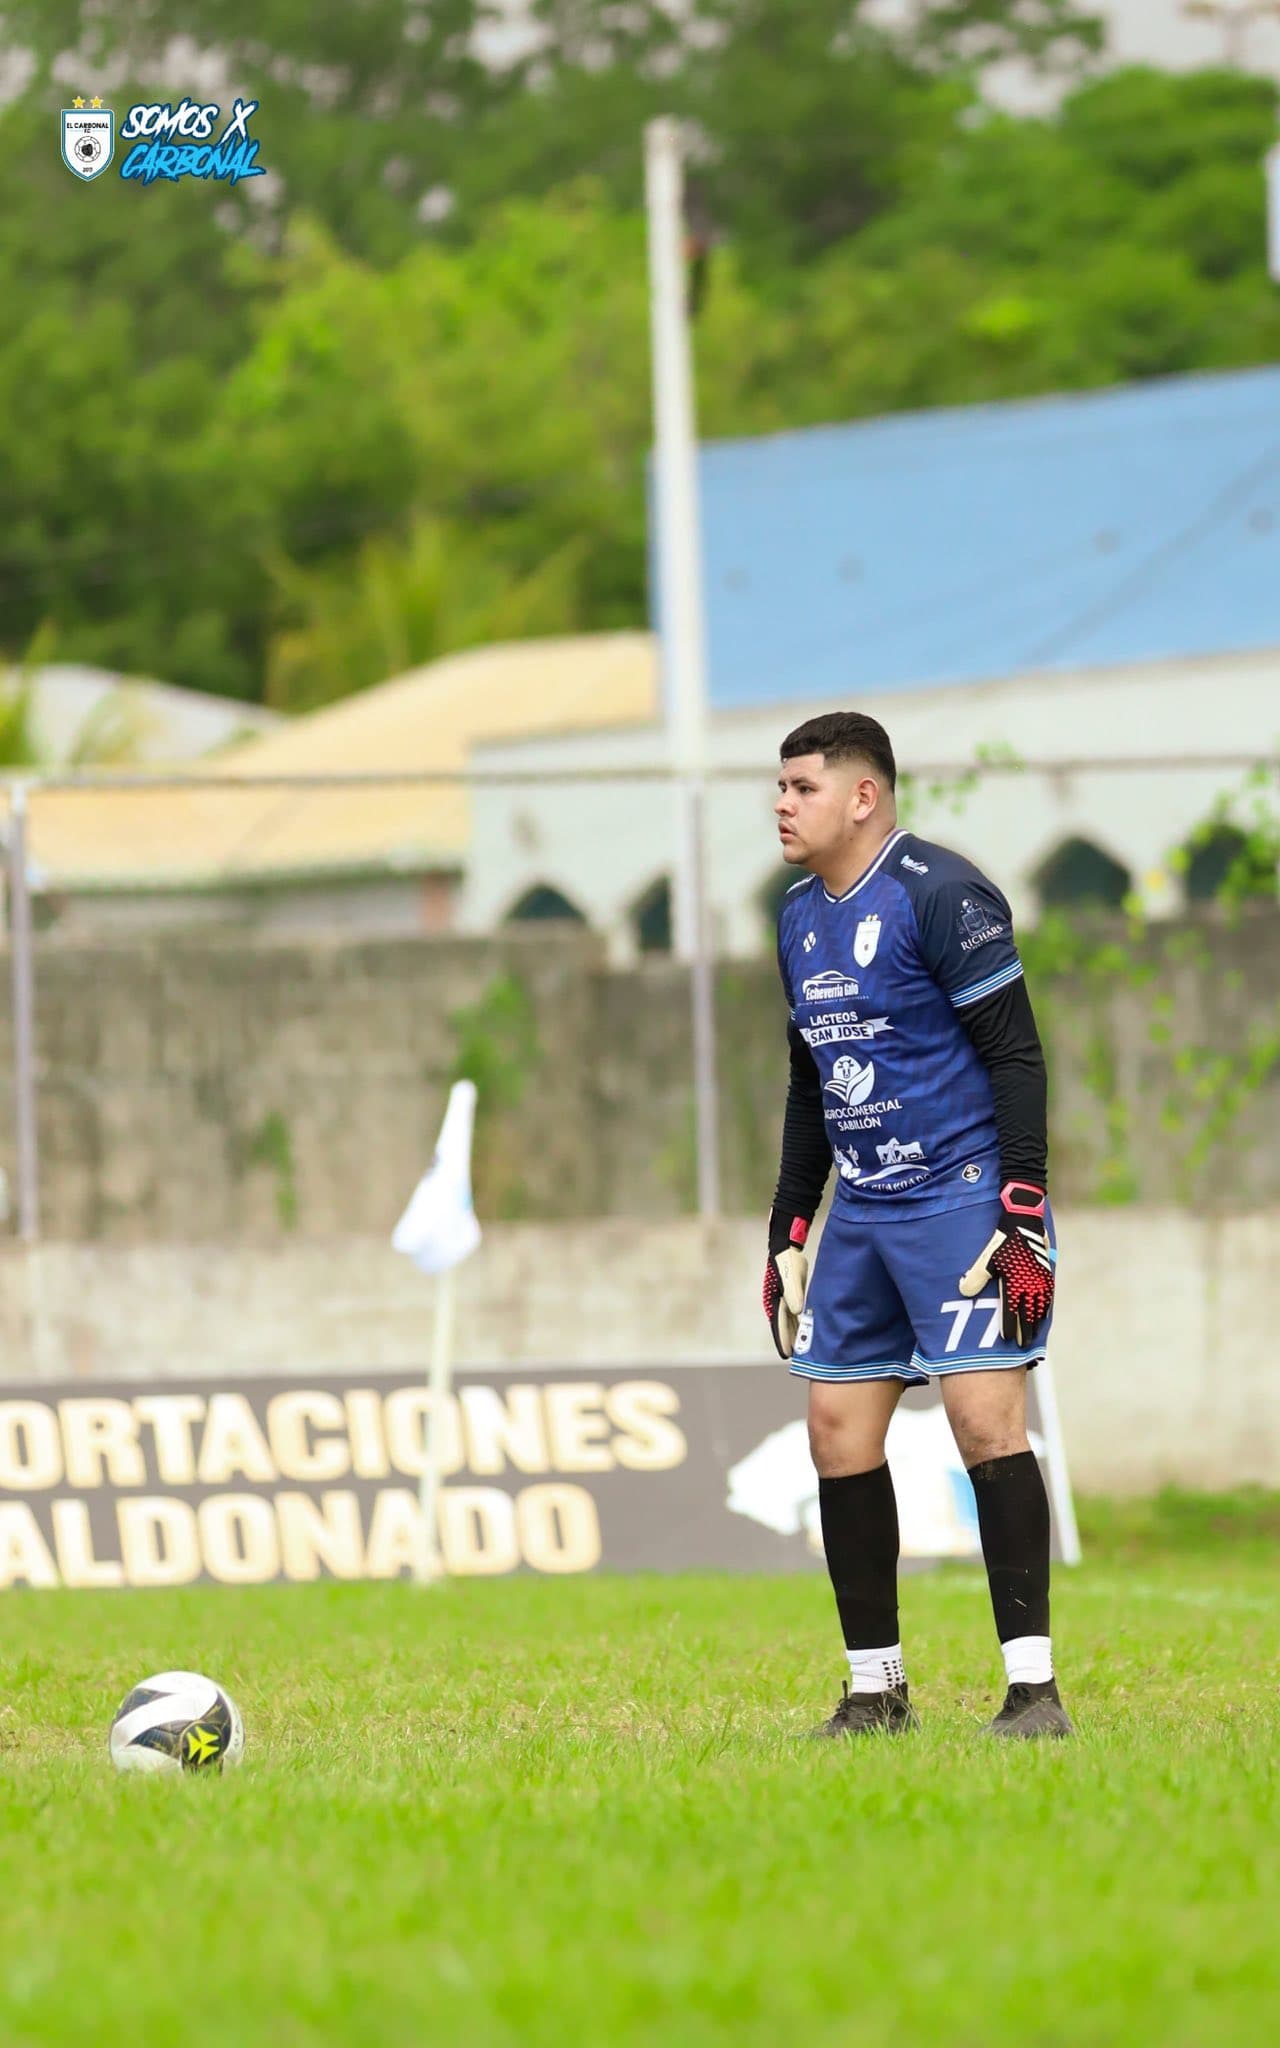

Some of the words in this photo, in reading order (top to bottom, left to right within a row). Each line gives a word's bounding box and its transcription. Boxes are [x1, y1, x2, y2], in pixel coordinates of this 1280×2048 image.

[960, 924, 1004, 951] RICHARS
[809, 1011, 858, 1027] LACTEOS
[810, 1028, 833, 1044] SAN
[837, 1026, 870, 1038] JOSE
[823, 1098, 903, 1120] AGROCOMERCIAL
[837, 1115, 882, 1132] SABILLÓN
[939, 1298, 1000, 1352] 77
[0, 1380, 688, 1490] ORTACIONES
[0, 1482, 602, 1590] ALDONADO
